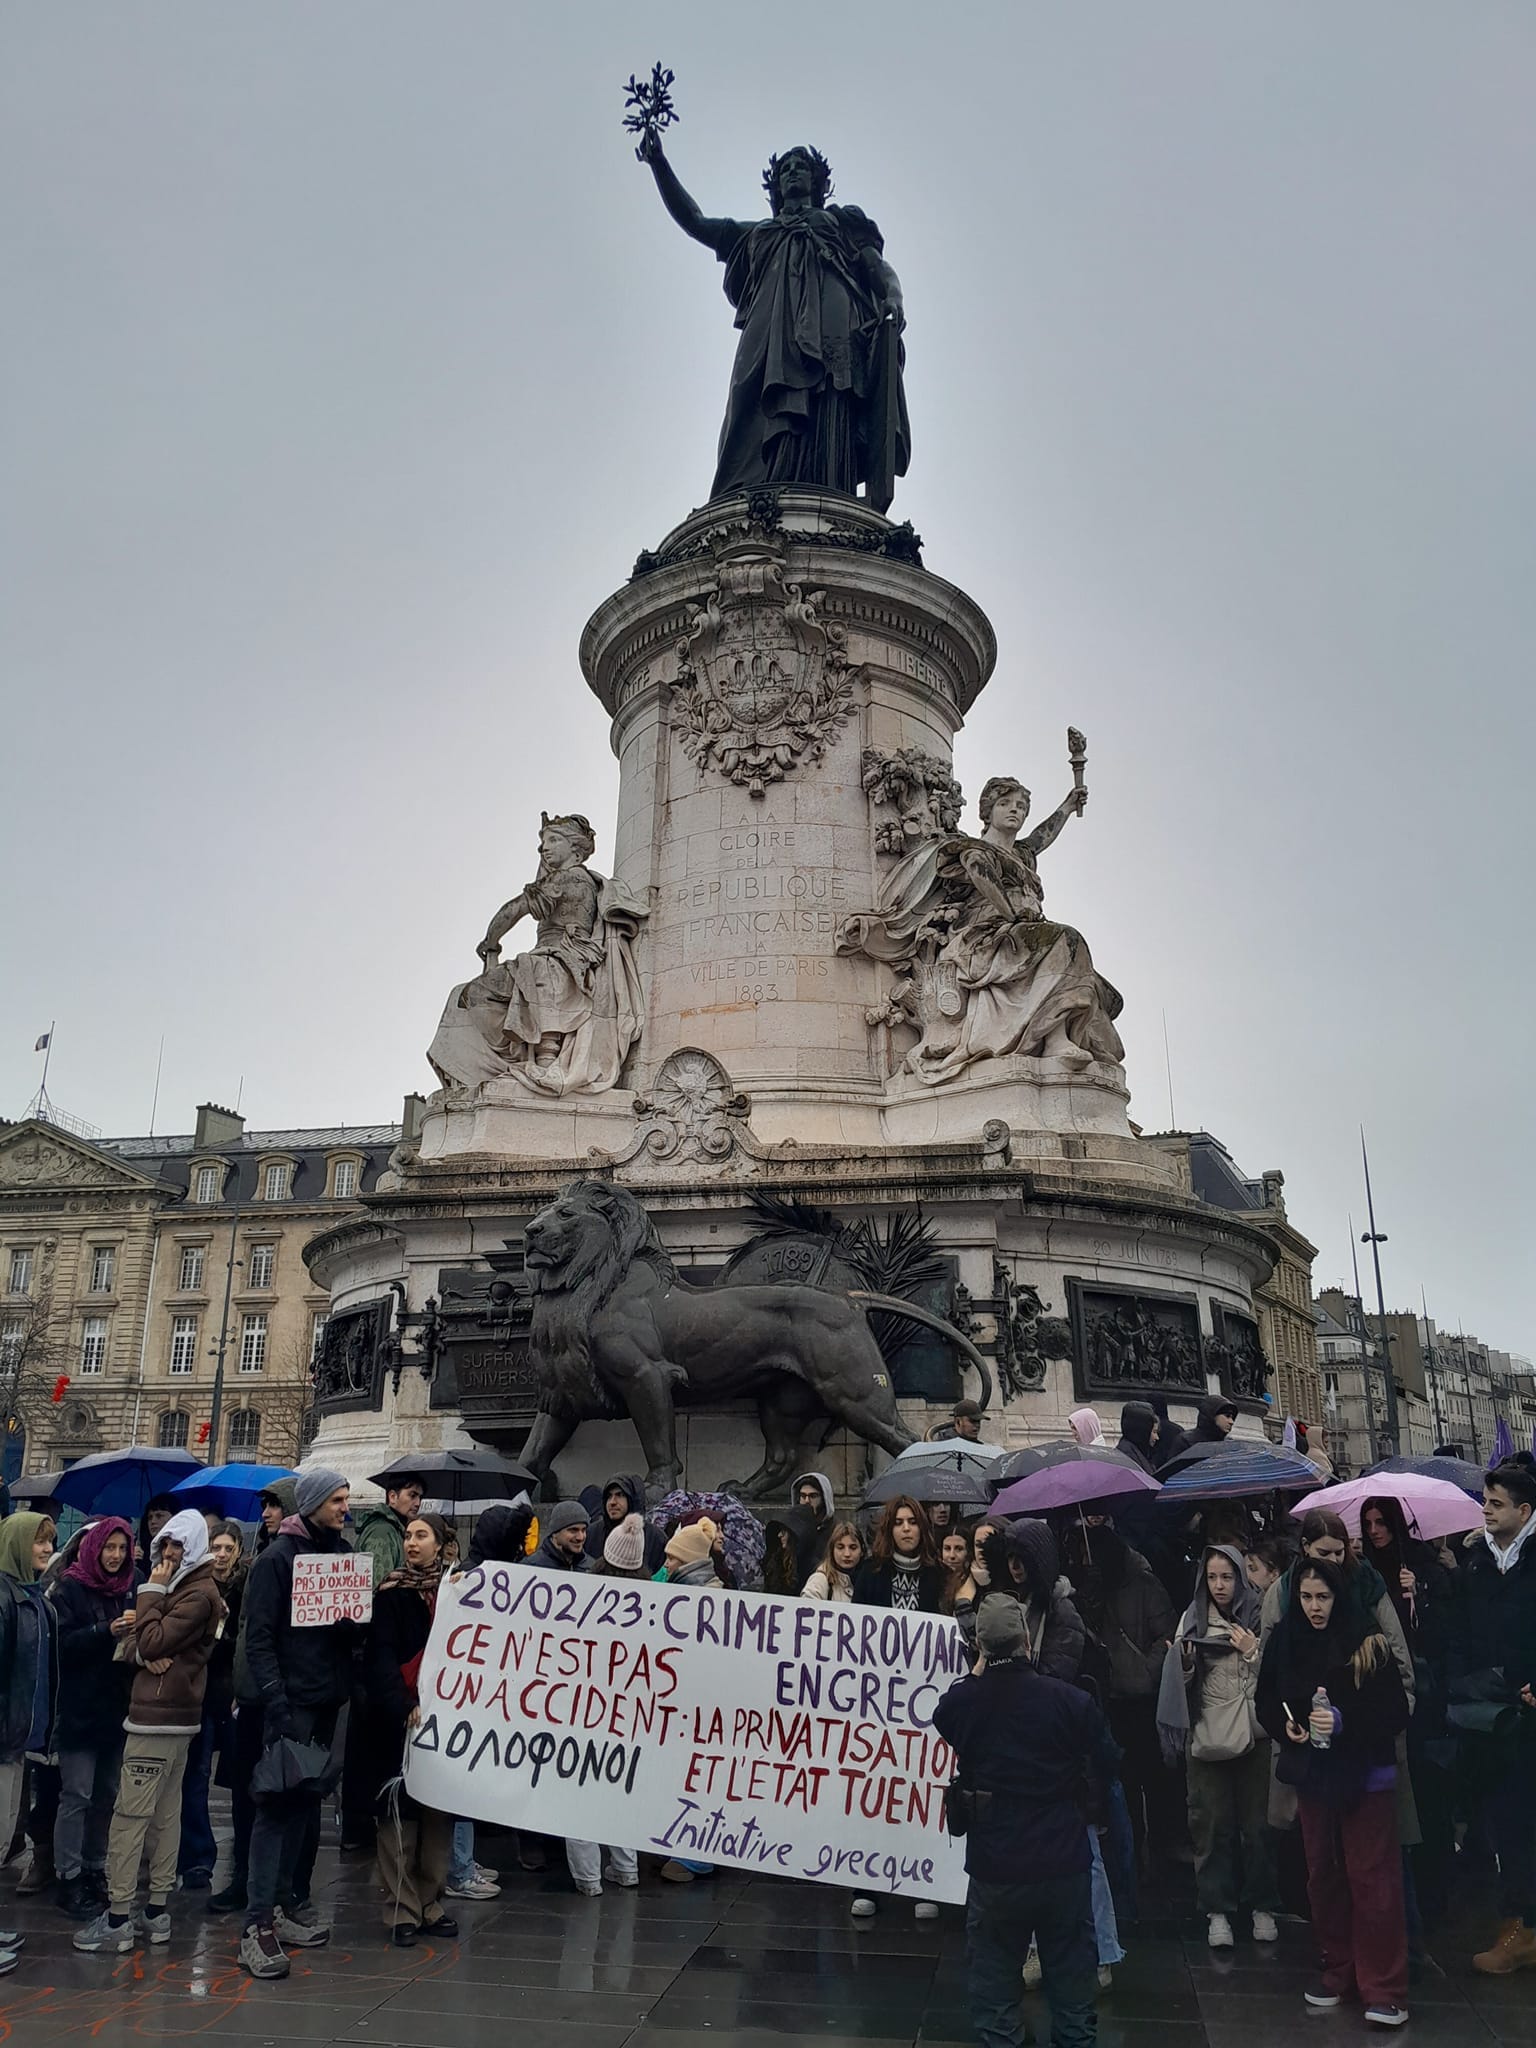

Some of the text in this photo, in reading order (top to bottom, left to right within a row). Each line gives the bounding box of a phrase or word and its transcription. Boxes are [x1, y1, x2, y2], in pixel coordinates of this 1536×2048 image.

[756, 811, 776, 823] LA
[719, 831, 796, 851] GLOIRE
[736, 856, 777, 869] DE LA
[678, 875, 846, 909] RÉPUBLIQUE
[689, 912, 832, 941] FRANÇAISE
[745, 941, 767, 953] LA
[690, 960, 829, 983] VILLE DE PARIS
[735, 983, 779, 1004] 1883
[761, 1247, 815, 1277] 1789
[1093, 1239, 1112, 1256] 20
[1155, 1249, 1178, 1266] 1789
[462, 1369, 537, 1388] UNIVERSE
[294, 1576, 315, 1592] PAS
[458, 1567, 656, 1629] 28/02/23:
[663, 1594, 785, 1655] CRIME
[446, 1623, 684, 1698] CE N'EST PAS
[436, 1666, 483, 1711] UN
[692, 1705, 724, 1745] LA
[776, 1661, 940, 1729] EN GRÈC
[684, 1751, 725, 1795] ET
[649, 1797, 935, 1892] Initiative grecque
